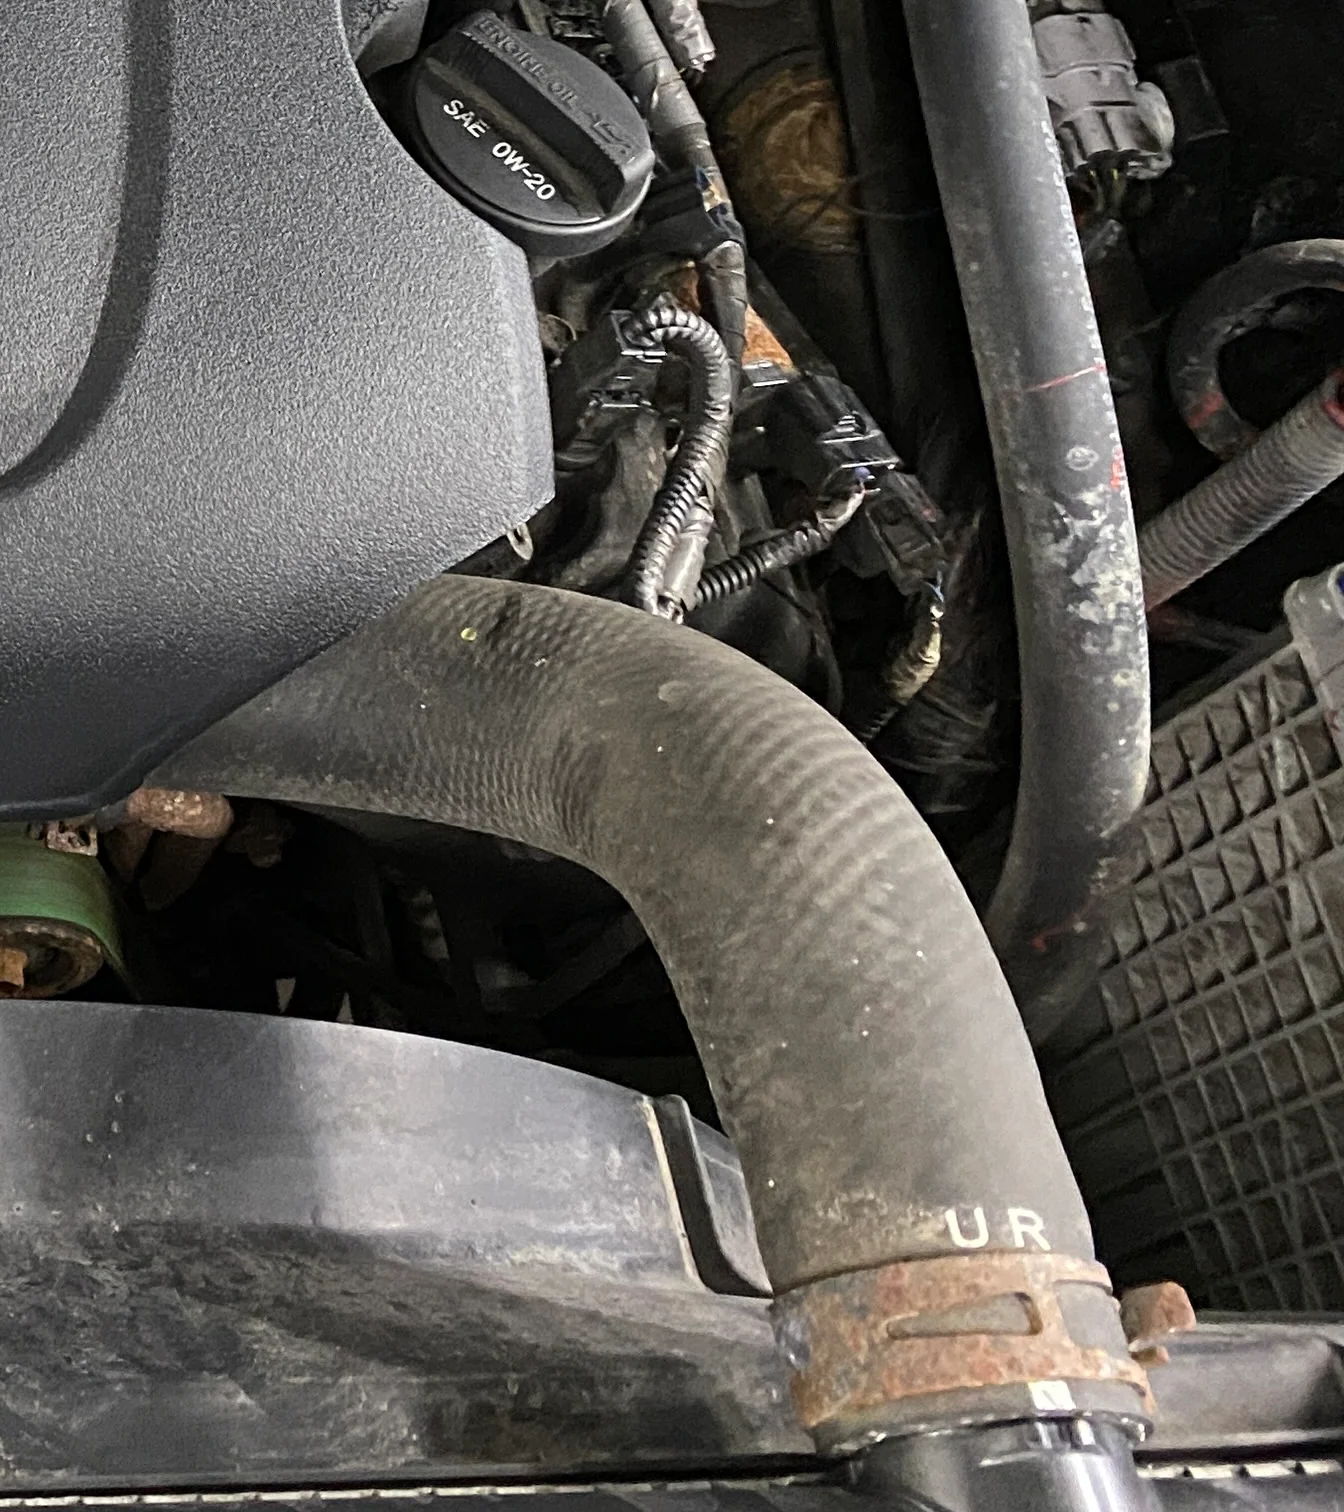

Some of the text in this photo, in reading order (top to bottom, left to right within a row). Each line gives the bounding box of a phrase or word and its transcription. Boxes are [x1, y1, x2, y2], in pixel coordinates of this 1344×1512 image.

[476, 19, 579, 109] ENGINE OIL
[443, 98, 557, 201] SAE 0W-20
